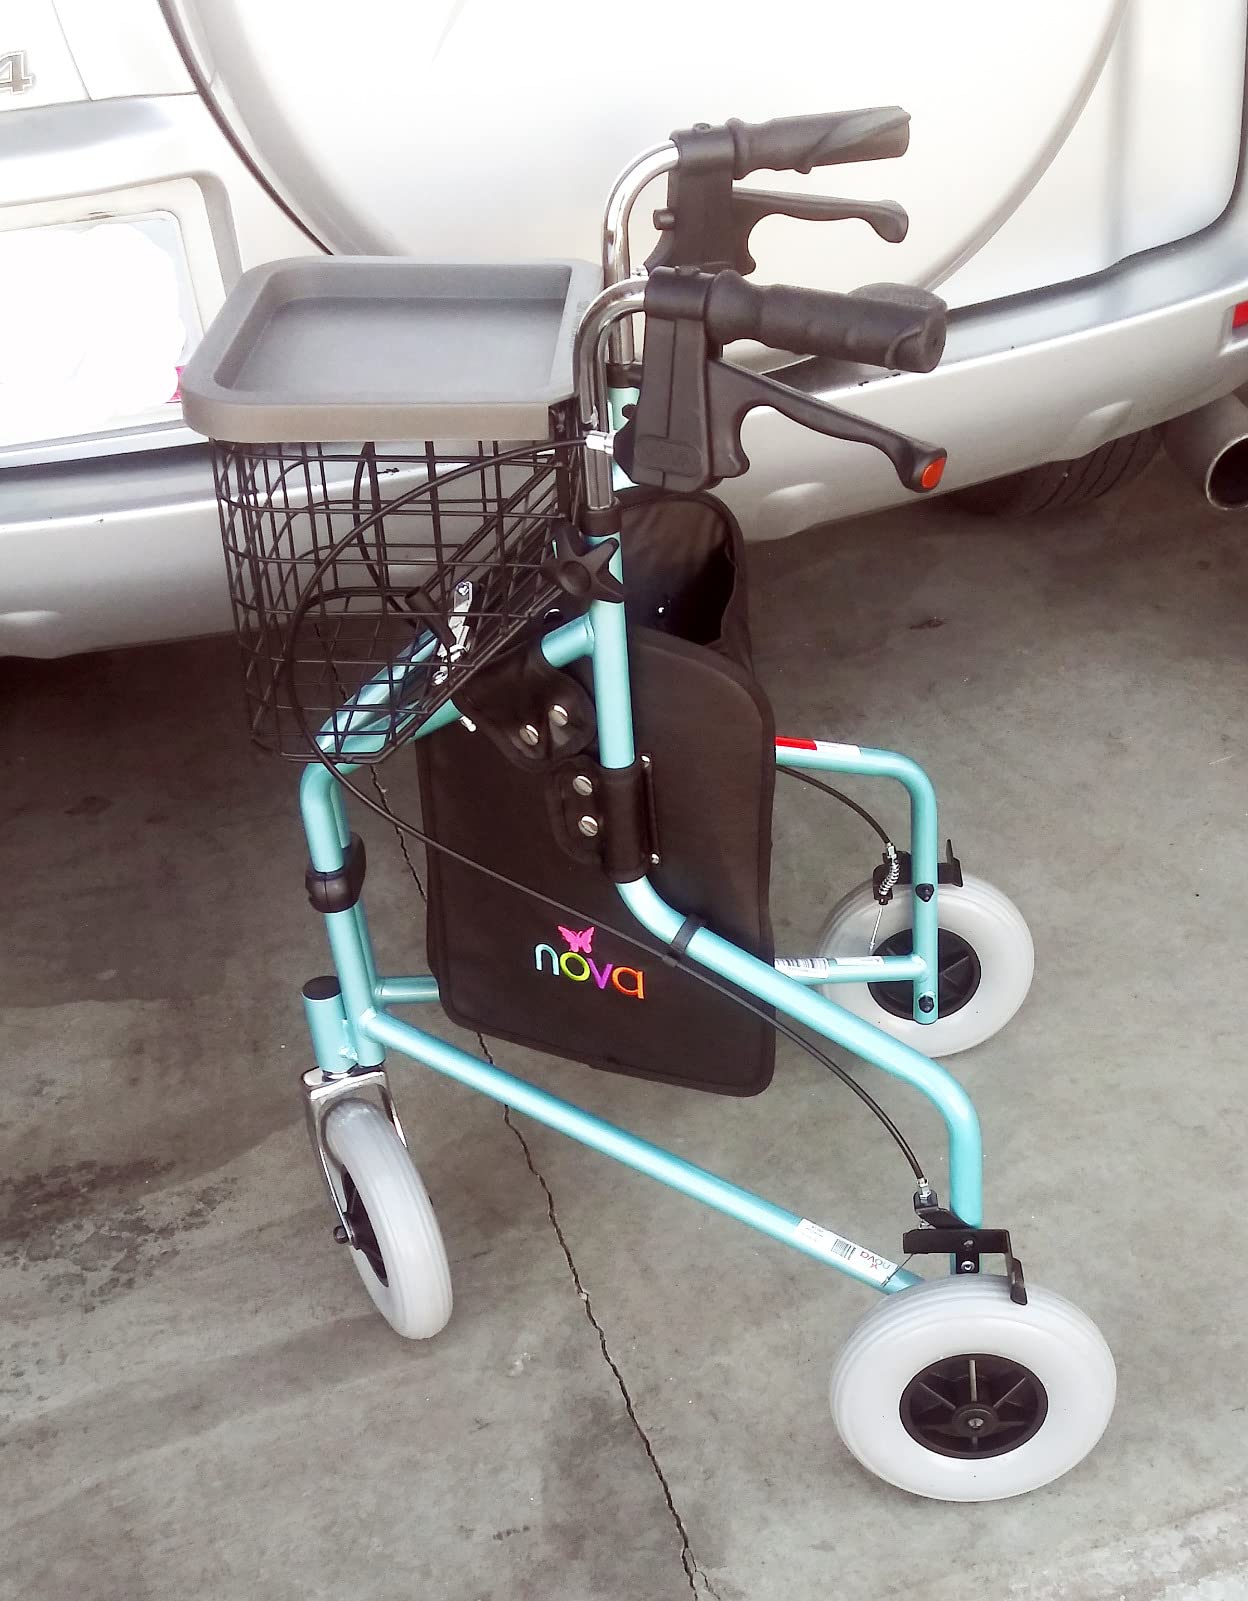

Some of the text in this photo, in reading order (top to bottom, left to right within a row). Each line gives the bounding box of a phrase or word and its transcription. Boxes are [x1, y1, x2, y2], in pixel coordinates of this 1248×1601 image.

[0, 52, 33, 95] 4
[535, 943, 644, 999] nova
[859, 1250, 891, 1270] nova
